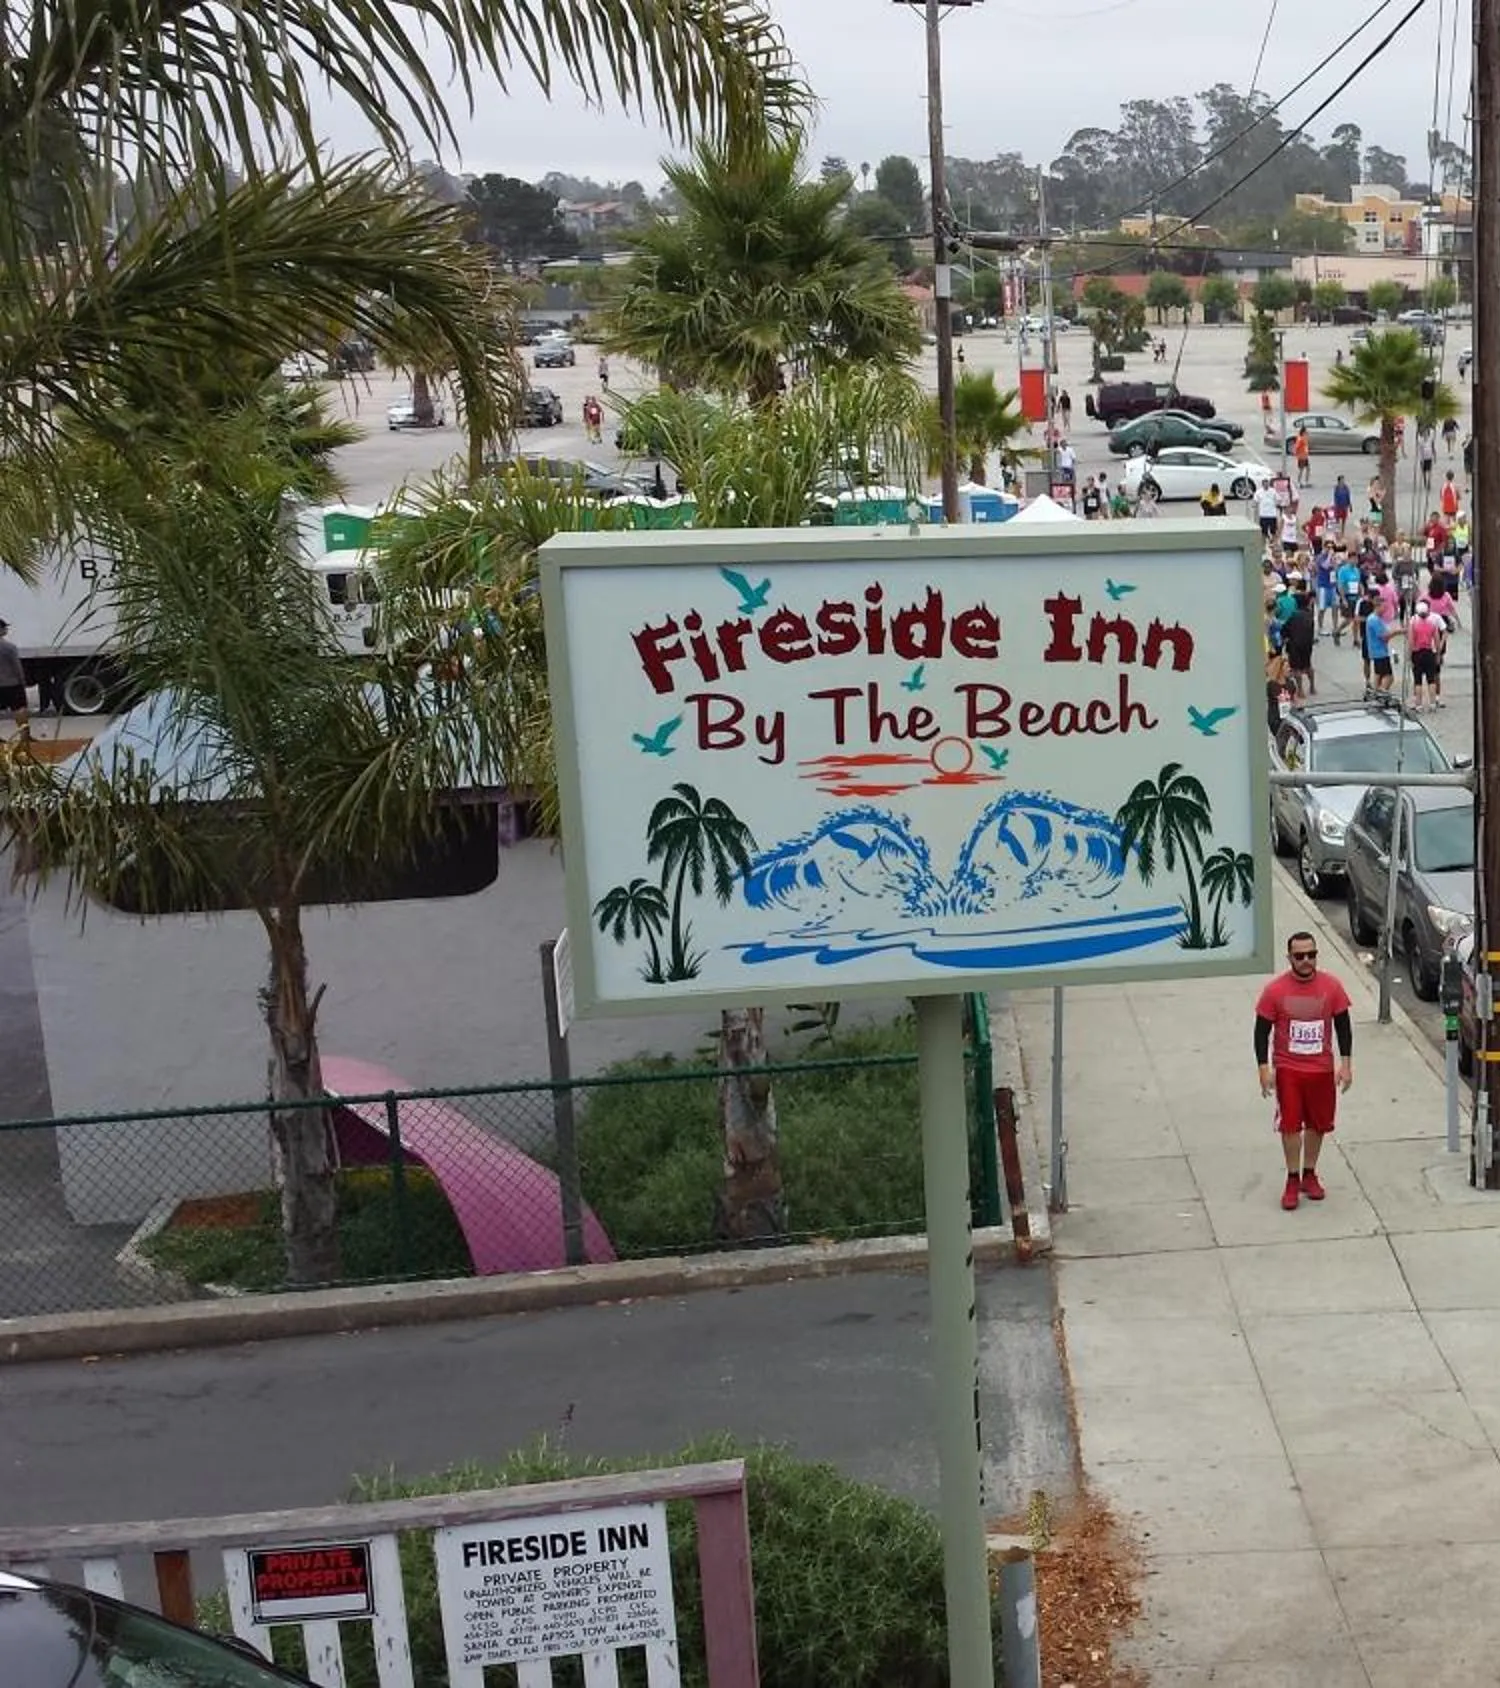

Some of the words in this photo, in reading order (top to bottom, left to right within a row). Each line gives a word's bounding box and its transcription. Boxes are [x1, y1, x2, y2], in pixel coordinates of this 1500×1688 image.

[631, 582, 1002, 694] Fireside
[1041, 589, 1195, 672] Inn
[684, 692, 787, 764] By
[808, 685, 941, 745] The
[954, 673, 1158, 740] Beach
[266, 1550, 353, 1572] PRIVATE
[462, 1532, 587, 1568] FIRESIDE
[598, 1523, 649, 1553] INN
[257, 1567, 363, 1589] PROPERTY
[464, 1582, 546, 1600] UNAUTHORIZED
[553, 1575, 601, 1589] VEHICLES
[607, 1570, 631, 1581] WILL
[639, 1567, 653, 1577] BE
[483, 1569, 542, 1586] PRIVATE
[553, 1558, 628, 1578] PROPERTY
[464, 1610, 494, 1622] OPEN
[501, 1604, 536, 1618] PUBLIC
[543, 1597, 591, 1612] PARKING
[597, 1589, 657, 1604] PROHIBITED
[476, 1596, 515, 1609] TOWED
[523, 1593, 534, 1603] AT
[597, 1579, 643, 1593] EXPENSE
[464, 1639, 499, 1652] SANTA
[506, 1635, 533, 1647] CRUZ
[541, 1630, 575, 1642] APTOS
[582, 1625, 606, 1637] TOW
